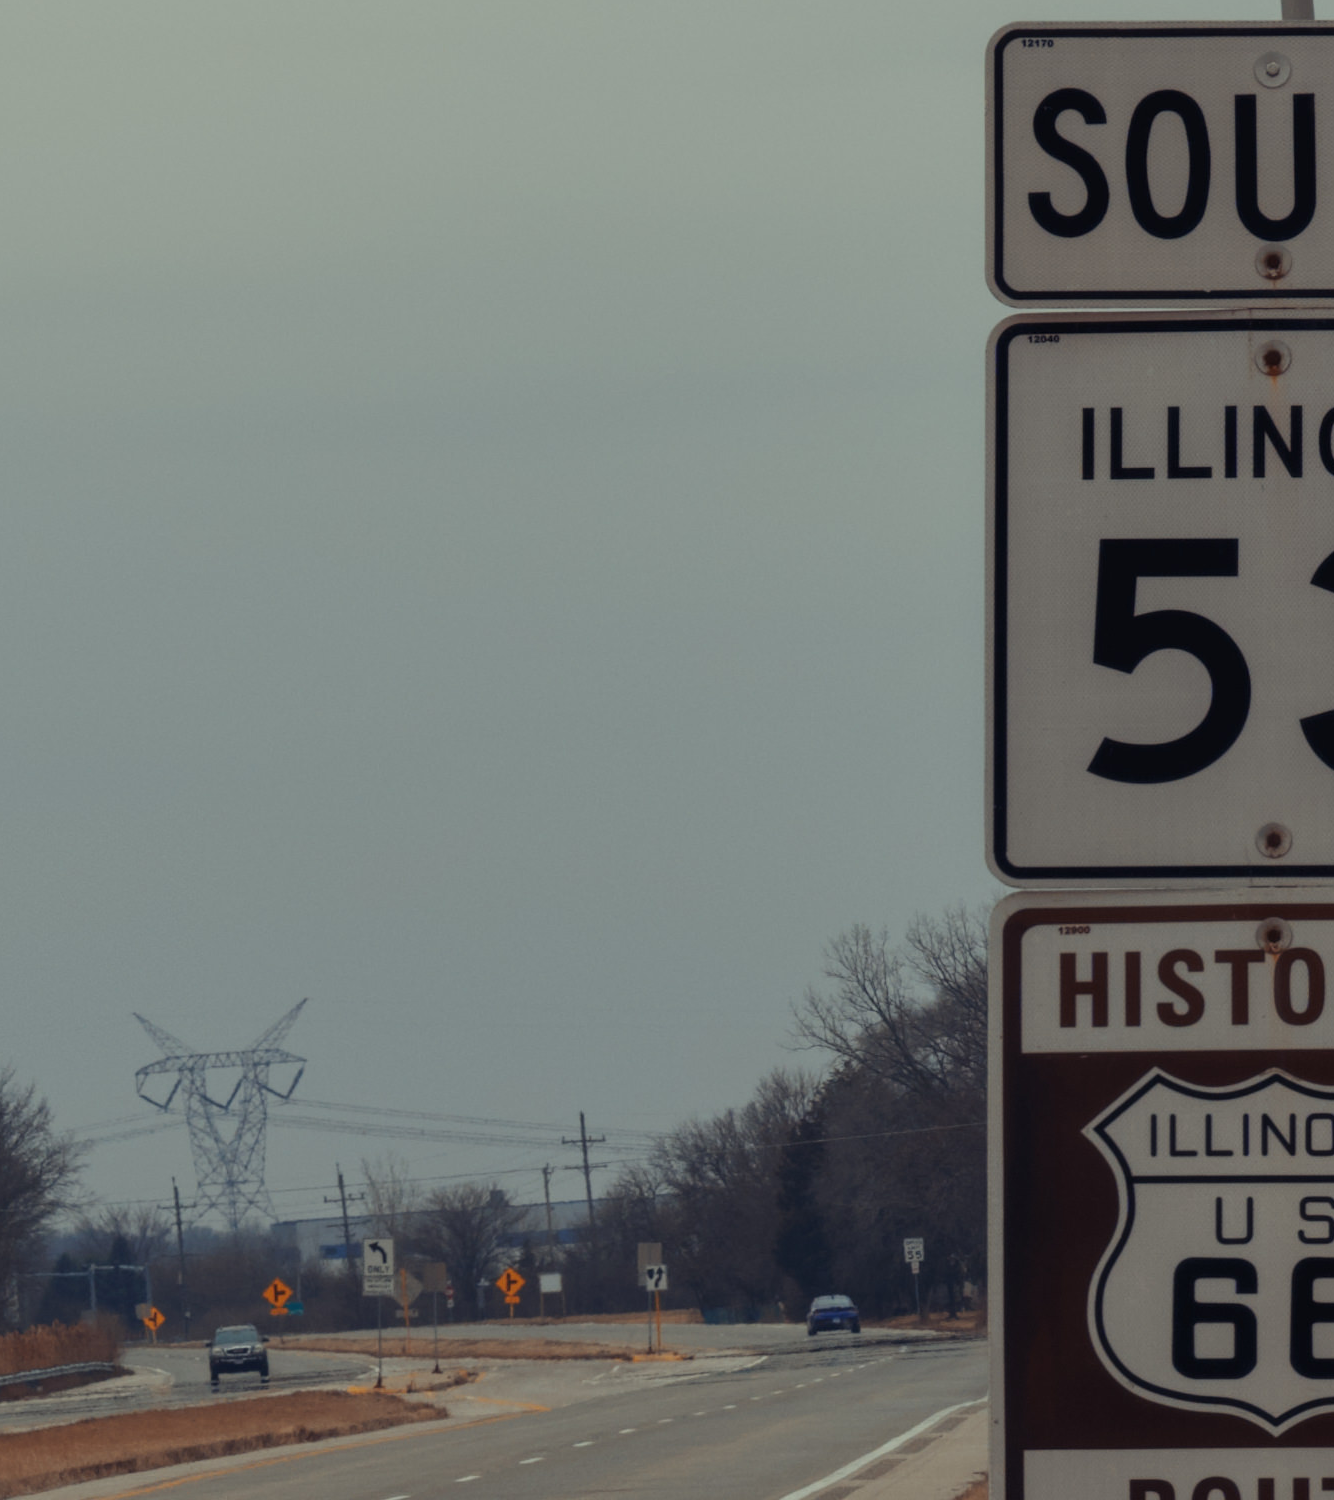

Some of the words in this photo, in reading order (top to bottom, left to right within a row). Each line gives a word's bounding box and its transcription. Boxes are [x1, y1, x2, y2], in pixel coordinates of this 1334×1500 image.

[1021, 38, 1055, 48] 12170
[1027, 334, 1060, 344] 12040
[368, 1265, 390, 1274] ONLY
